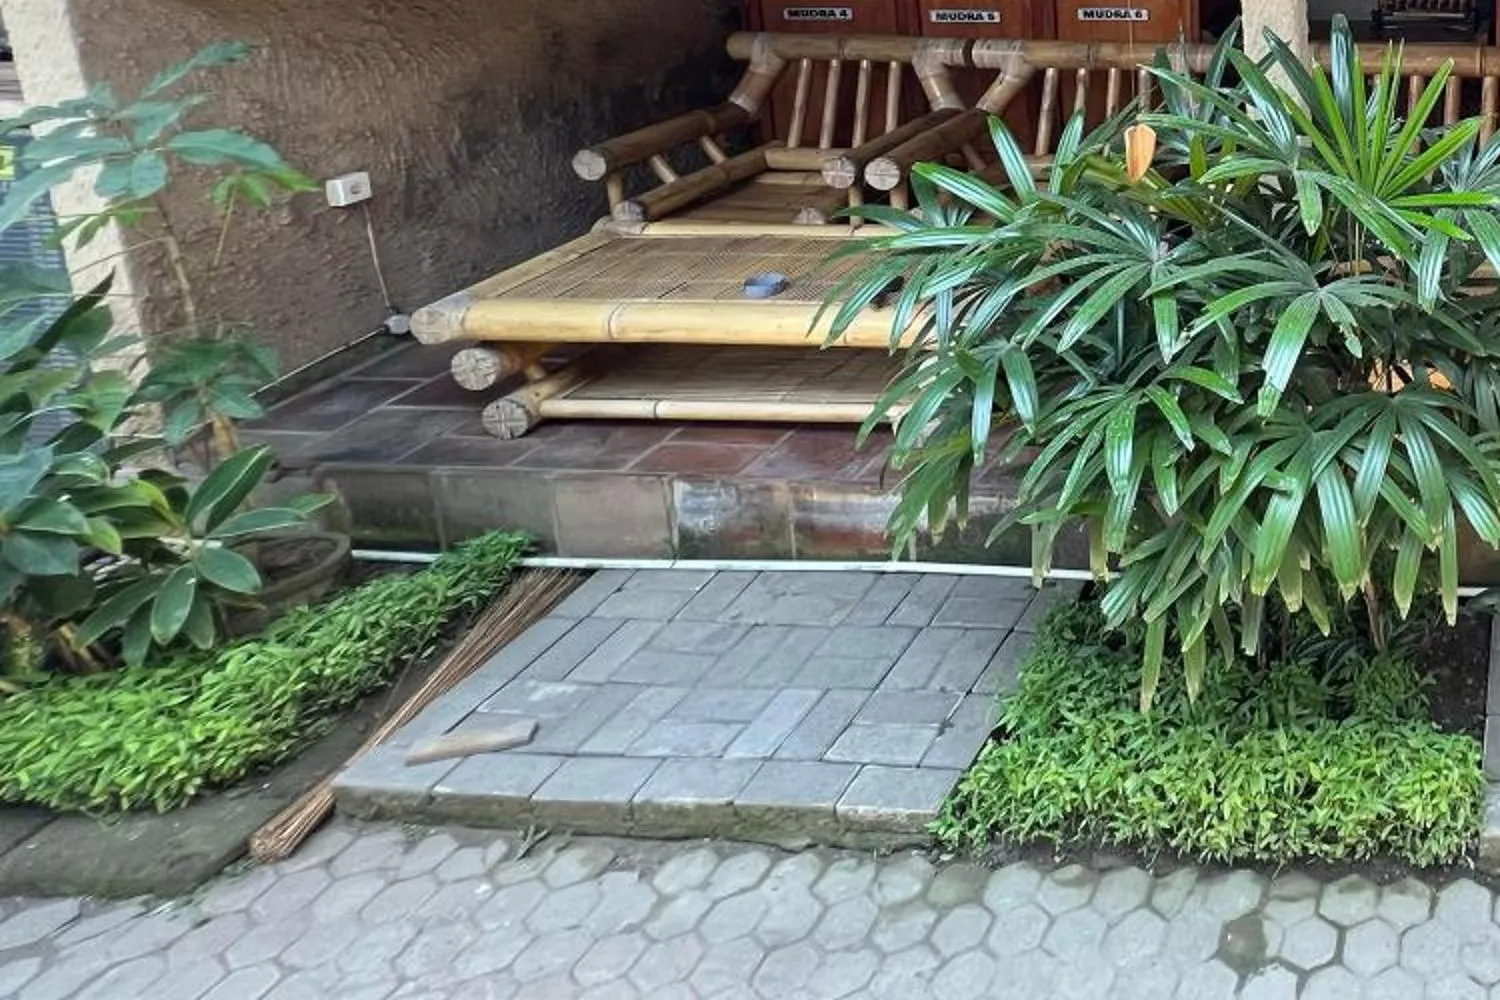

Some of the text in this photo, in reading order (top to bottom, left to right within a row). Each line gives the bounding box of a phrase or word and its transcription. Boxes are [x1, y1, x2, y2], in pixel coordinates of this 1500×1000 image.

[786, 8, 837, 18] MUDRA
[935, 11, 984, 21] MUDRA
[1082, 9, 1132, 19] MUDRA
